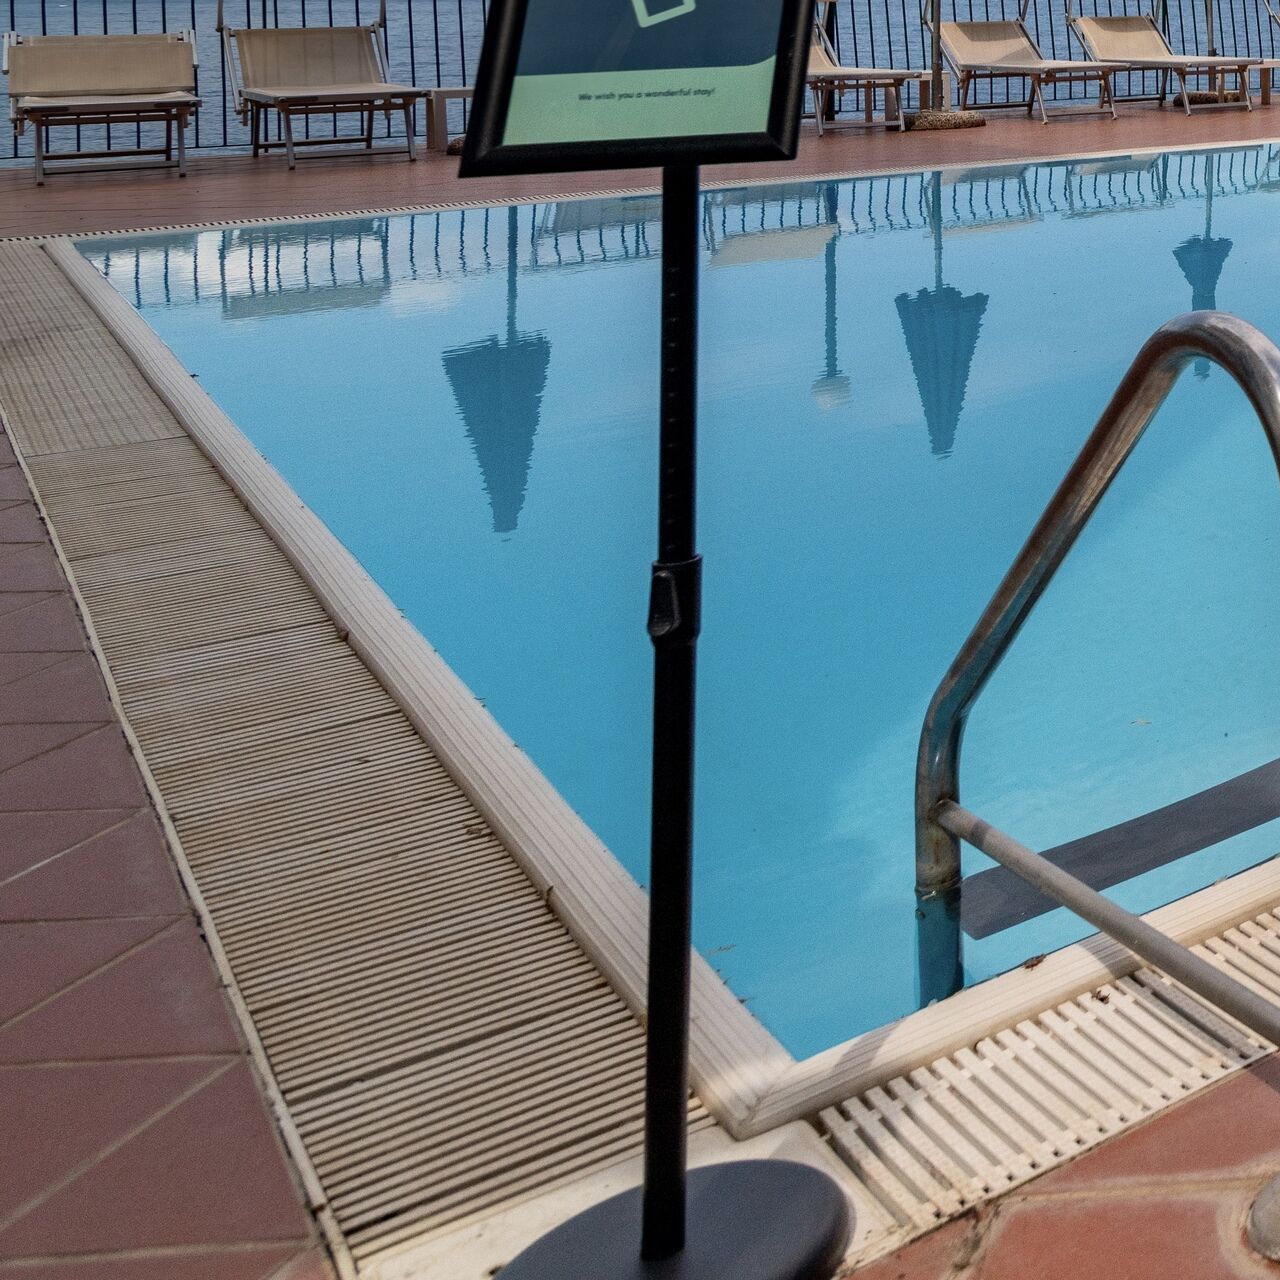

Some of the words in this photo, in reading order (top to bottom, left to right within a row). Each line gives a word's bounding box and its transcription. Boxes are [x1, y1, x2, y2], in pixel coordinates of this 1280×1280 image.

[578, 92, 592, 100] We
[595, 91, 616, 100] wish
[617, 92, 634, 101] you
[644, 88, 692, 97] wonderful
[693, 87, 716, 96] stay!
